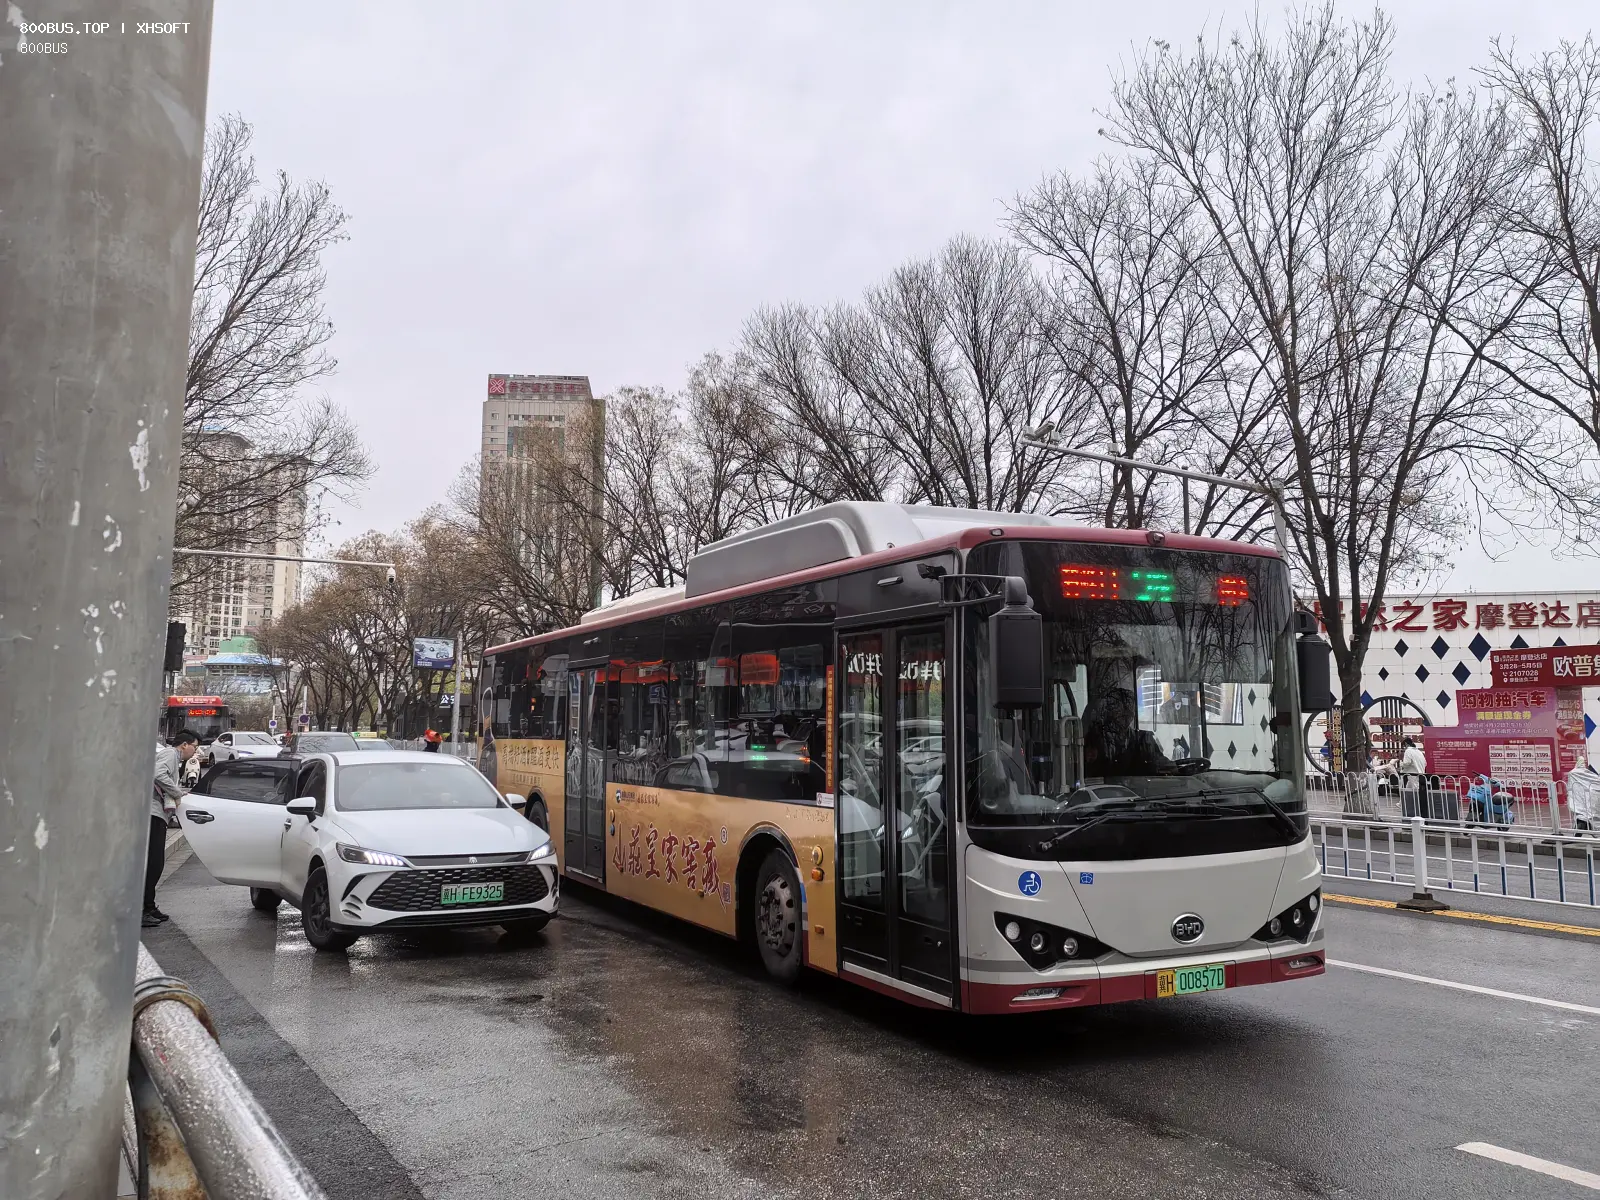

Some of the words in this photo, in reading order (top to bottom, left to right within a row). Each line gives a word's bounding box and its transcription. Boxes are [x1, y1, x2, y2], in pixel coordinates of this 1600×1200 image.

[1461, 690, 1547, 709] 购物抽汽车
[462, 885, 503, 901] FE9325
[1176, 921, 1201, 936] BYD
[1180, 968, 1224, 991] 00857D
